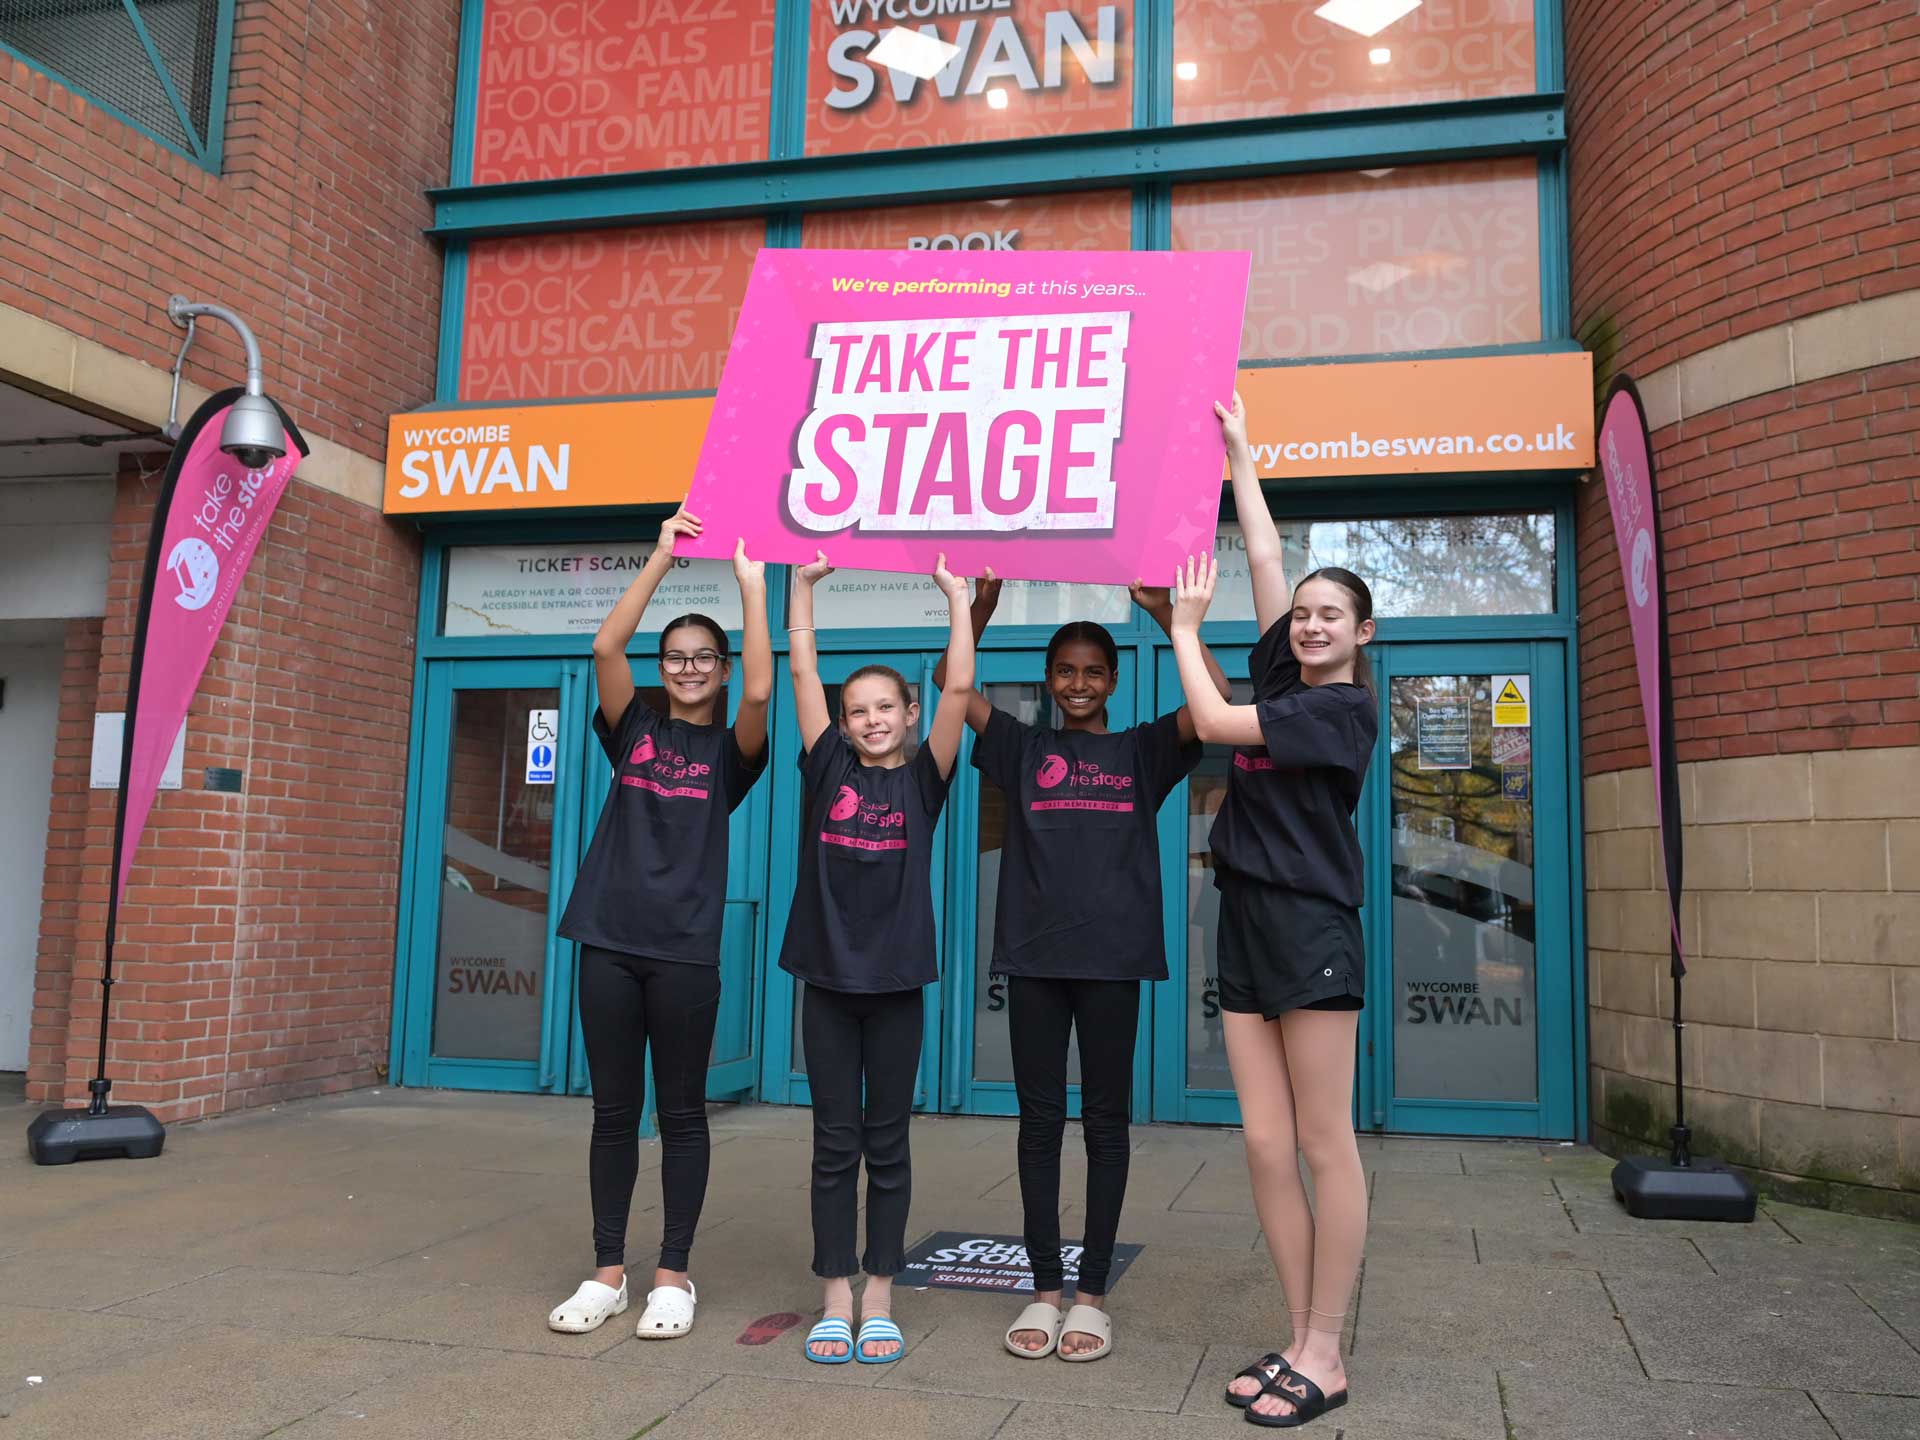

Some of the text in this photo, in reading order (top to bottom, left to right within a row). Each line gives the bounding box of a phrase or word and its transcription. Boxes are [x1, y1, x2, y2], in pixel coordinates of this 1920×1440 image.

[490, 2, 607, 45] ROCK
[485, 26, 708, 85] MUSICALS
[824, 6, 1117, 109] SWAN
[483, 78, 611, 125] FOOD
[480, 102, 761, 165] PANTOMIME
[470, 265, 723, 319] ROCK JAZZ
[831, 276, 889, 292] We're
[892, 278, 1012, 298] performing
[1015, 280, 1036, 295] at
[1041, 280, 1078, 296] this
[466, 309, 696, 360] MUSICALS
[1375, 301, 1533, 351] ROCK
[829, 325, 1113, 394] TAKE THE
[403, 425, 511, 447] WYCOMBE
[399, 443, 571, 499] SWAN
[804, 408, 1106, 517] STAGE
[193, 473, 233, 532] take
[214, 507, 246, 551] the
[517, 556, 584, 574] TICKET
[481, 588, 528, 598] ALREADY
[529, 588, 558, 598] HAVE
[557, 588, 566, 597] A
[567, 587, 583, 598] QR
[584, 586, 617, 597] CODE?
[658, 584, 691, 594] ENTER
[481, 600, 540, 611] ACCESSIBLE
[541, 599, 592, 610] ENTRANCE
[596, 599, 619, 609] WIT
[685, 595, 720, 606] DOORS
[828, 582, 879, 593] ALREADY
[880, 581, 911, 592] HAVE
[911, 581, 921, 591] A
[1091, 771, 1133, 790] stage
[1064, 801, 1098, 809] MEMBER
[450, 957, 507, 968] WYCOMBE
[448, 967, 537, 996] SWAN
[1407, 981, 1481, 994] WYCOMBE
[1407, 994, 1522, 1027] SWAN
[906, 1262, 929, 1271] ARE
[932, 1264, 953, 1273] YOU
[957, 1265, 996, 1275] BRAVE
[996, 1268, 1035, 1278] ENOUG
[935, 1273, 1017, 1288] SCAN HERE
